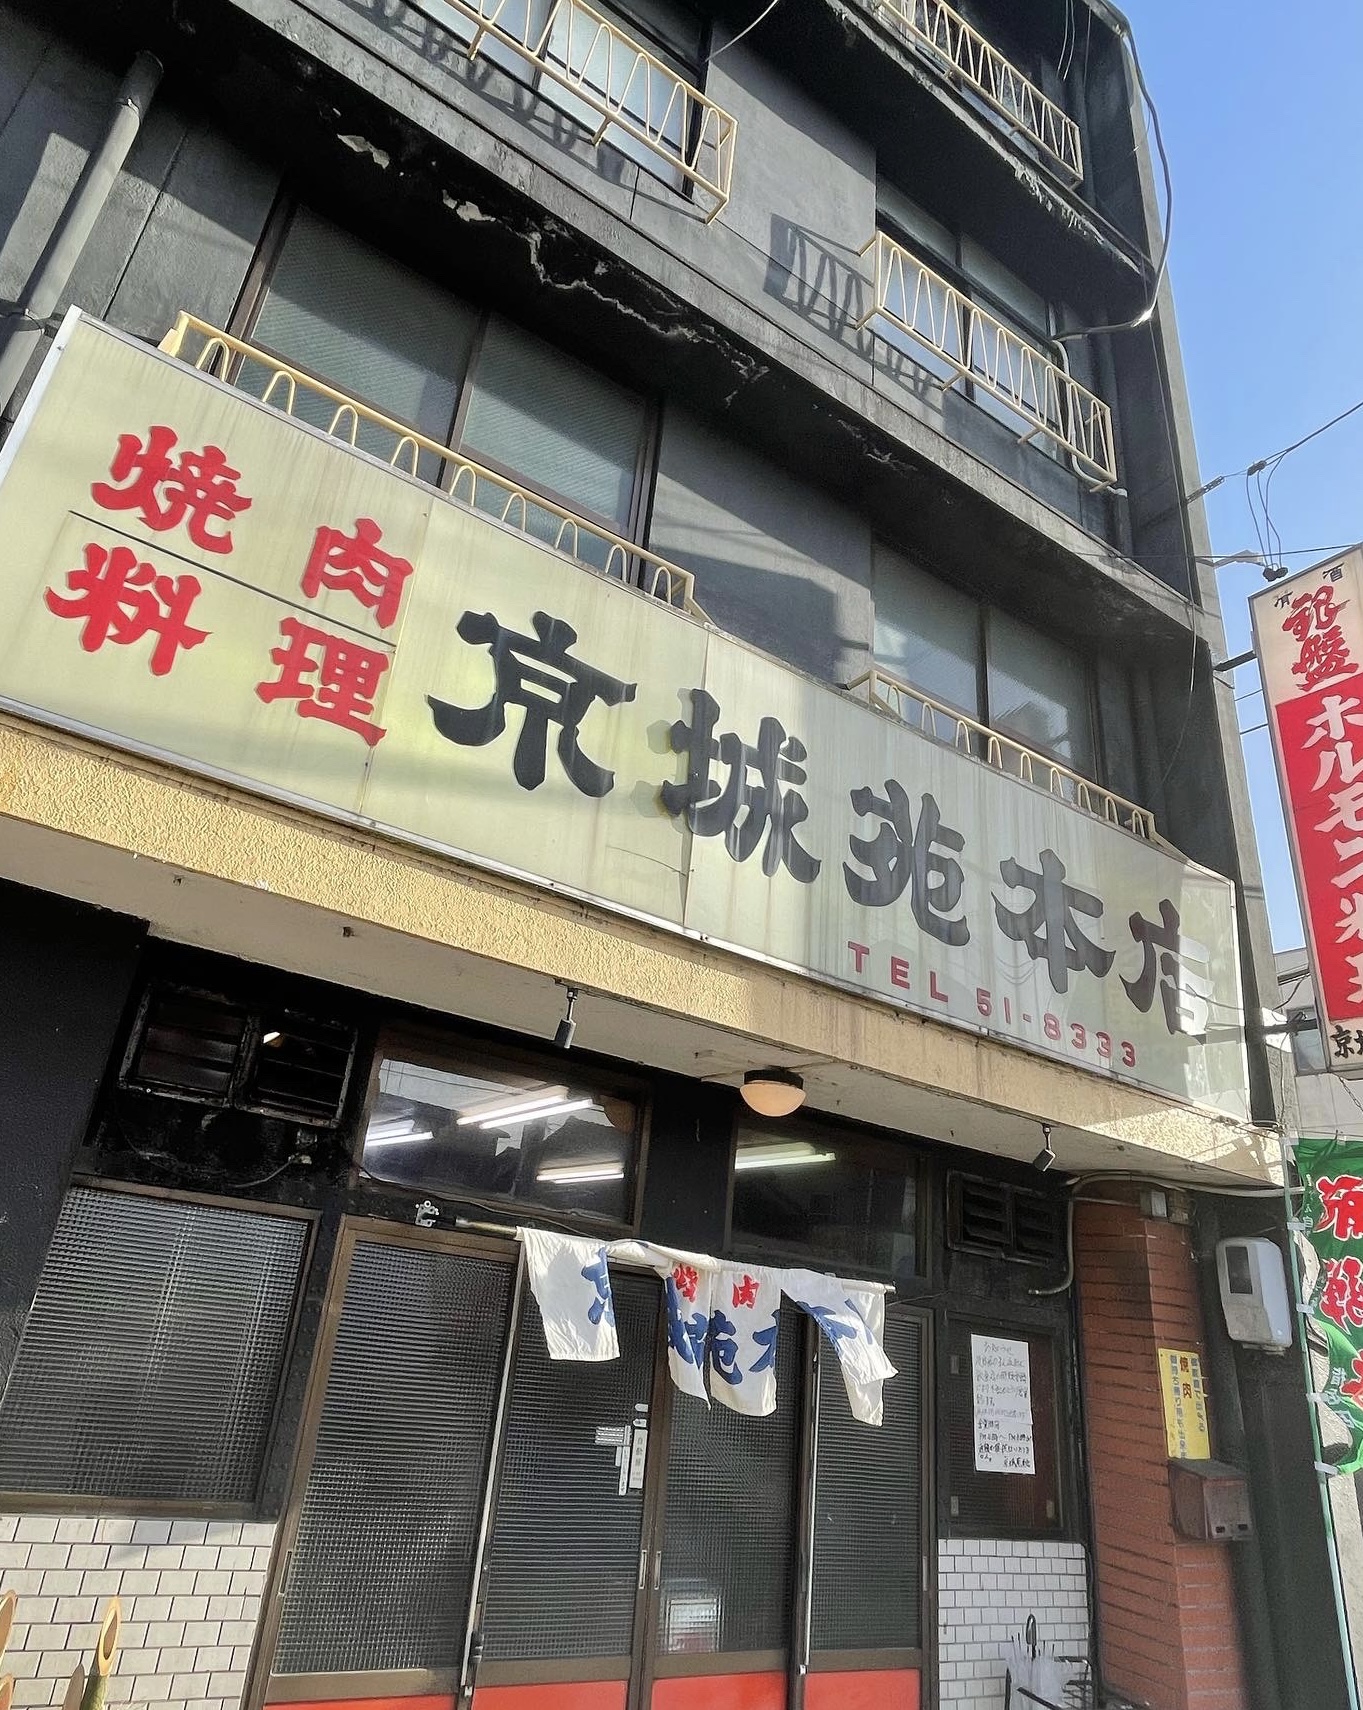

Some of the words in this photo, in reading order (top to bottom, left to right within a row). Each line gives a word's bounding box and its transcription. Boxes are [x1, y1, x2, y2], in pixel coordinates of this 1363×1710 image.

[90, 425, 412, 629] 焼肉
[44, 542, 391, 748] 料理
[847, 940, 950, 1004] TEL
[976, 986, 1138, 1069] 51-8333
